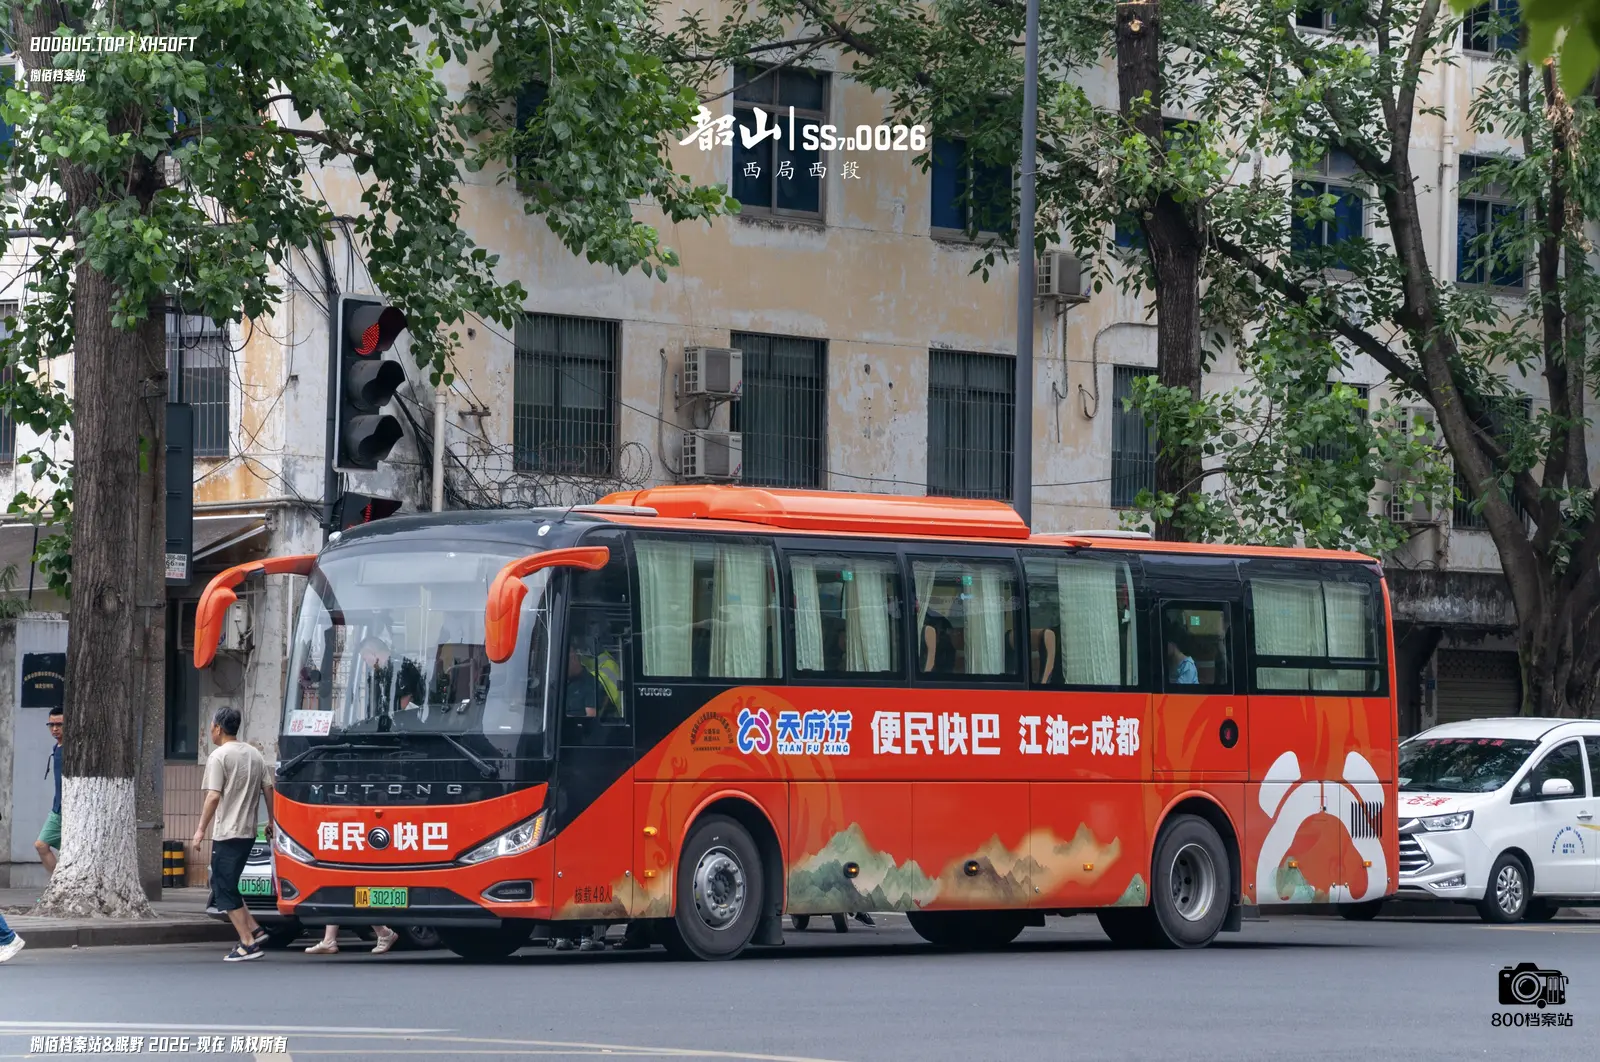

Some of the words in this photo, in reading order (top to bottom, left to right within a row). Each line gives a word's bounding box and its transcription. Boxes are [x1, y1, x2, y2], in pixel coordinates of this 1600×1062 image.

[638, 687, 672, 696] YUTONG
[777, 711, 852, 741] 天府行
[870, 711, 1001, 755] 便民快巴
[1018, 715, 1069, 755] 江油
[1090, 715, 1140, 756] 成都
[779, 744, 802, 752] TIAN
[807, 744, 819, 752] FU
[825, 744, 849, 753] XING
[311, 784, 462, 795] YUTONG
[317, 822, 365, 850] 便民
[393, 822, 449, 851] 快巴
[574, 886, 612, 903] 核载48人
